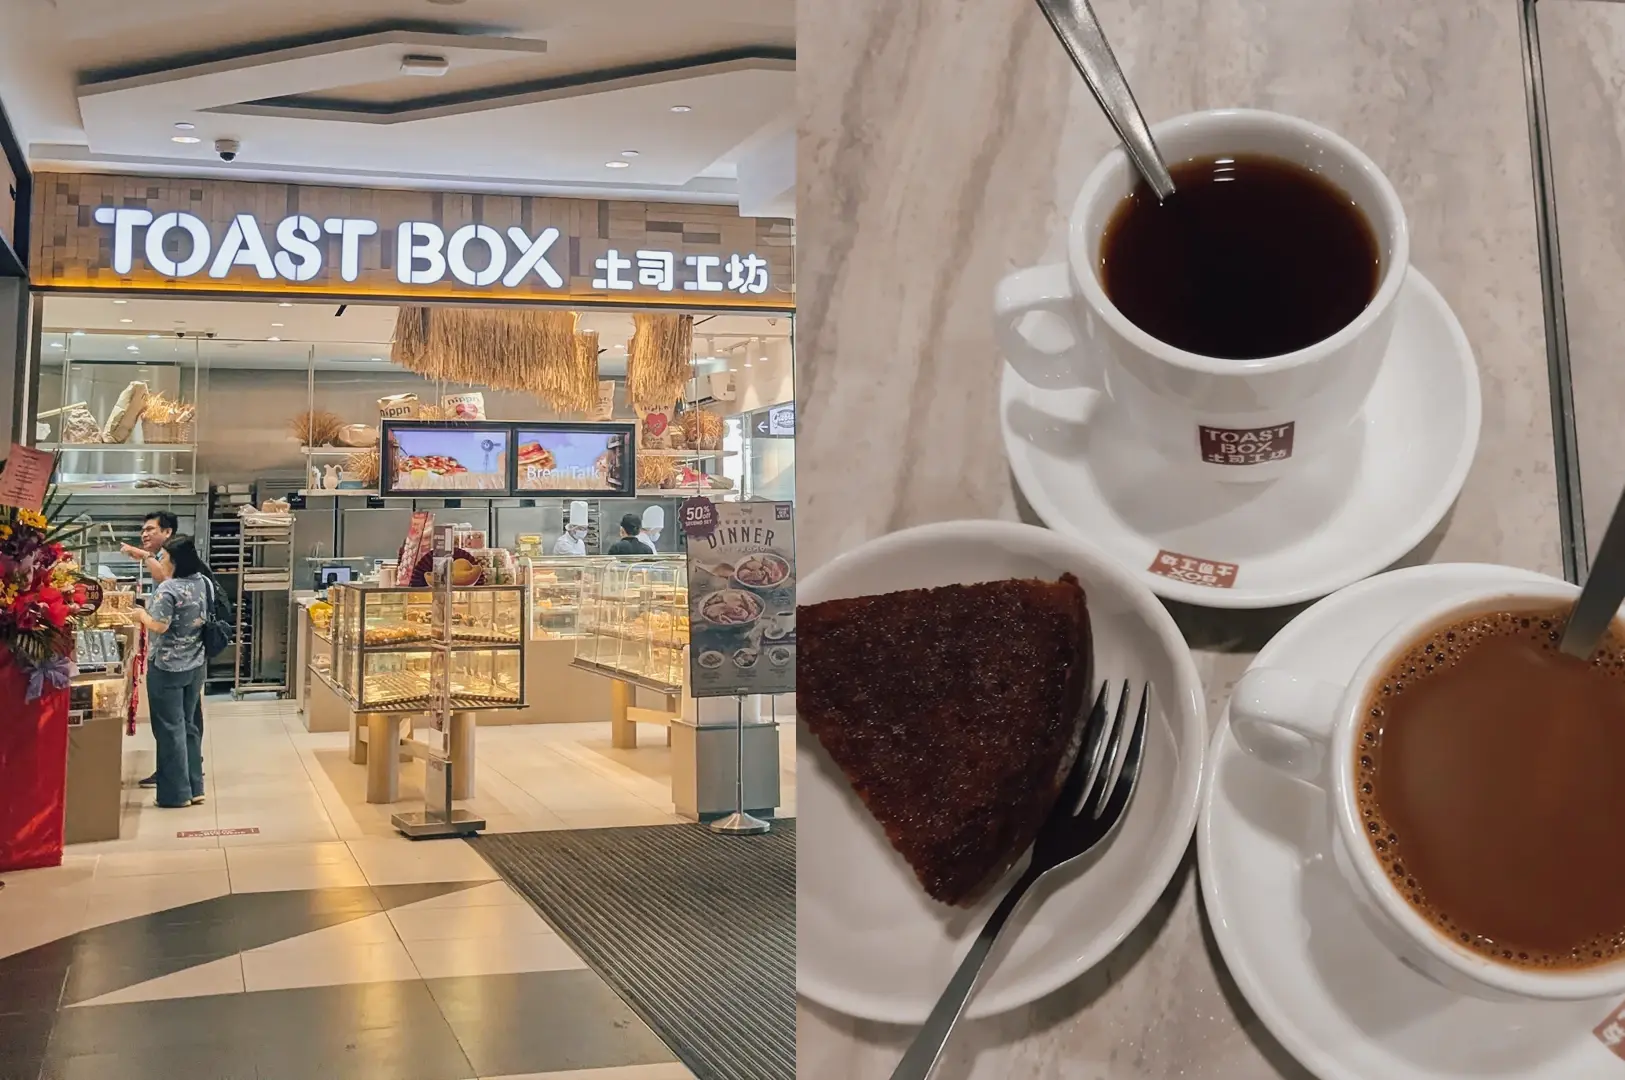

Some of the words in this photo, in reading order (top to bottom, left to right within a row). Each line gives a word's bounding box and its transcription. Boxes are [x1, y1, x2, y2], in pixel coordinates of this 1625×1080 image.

[94, 207, 378, 283] TOAST
[397, 221, 563, 289] BOX
[592, 249, 768, 294] 土司工坊
[380, 405, 411, 418] nippn
[1205, 426, 1289, 443] TOAST
[1220, 441, 1273, 454] BOX
[1208, 449, 1287, 464] 土司工坊
[708, 526, 775, 549] DINNER
[1171, 567, 1218, 583] BOX
